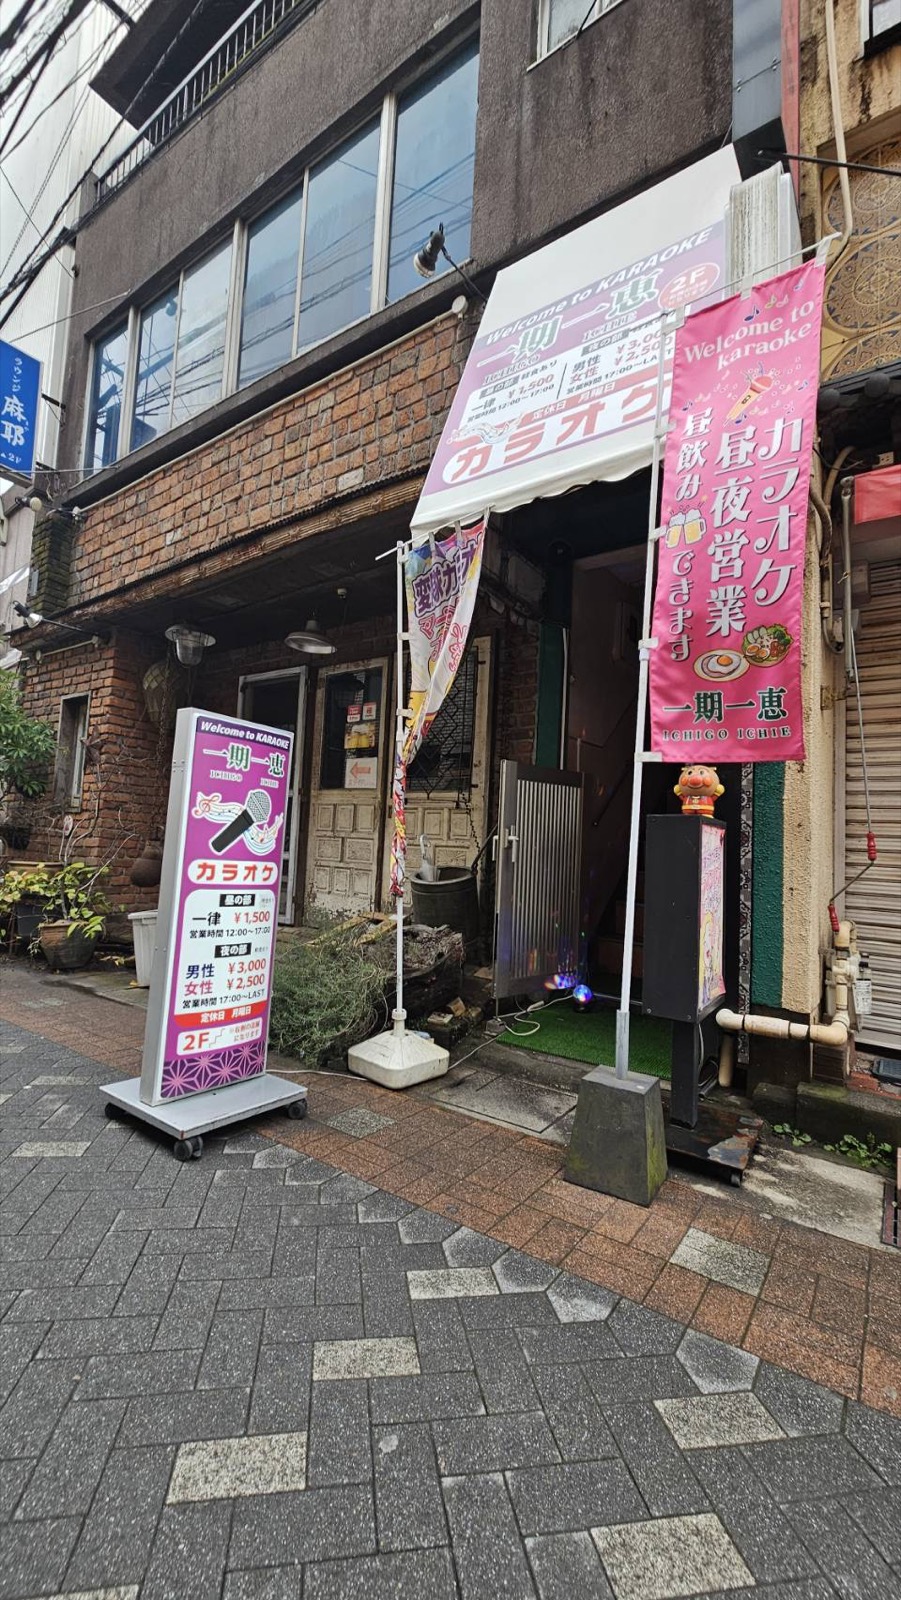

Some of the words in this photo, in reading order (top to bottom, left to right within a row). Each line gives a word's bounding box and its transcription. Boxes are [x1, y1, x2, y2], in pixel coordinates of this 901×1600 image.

[487, 298, 568, 345] Welcome
[571, 287, 592, 307] to
[598, 228, 712, 292] KARAOKE
[670, 266, 706, 293] 2F
[684, 316, 782, 363] Welcome
[791, 300, 815, 323] to
[717, 322, 812, 371] karaoke
[572, 355, 600, 373] 男性
[569, 366, 598, 385] 女性
[471, 398, 496, 411] 一律
[533, 400, 566, 419] 定休日
[578, 382, 615, 403] 月曜日
[675, 407, 713, 502] 昼飲み
[751, 417, 804, 607] カラオケ
[705, 425, 759, 638] 昼夜営業
[668, 550, 695, 662] できます
[663, 687, 787, 723] 一期一恵
[201, 721, 245, 739] Welcome
[245, 731, 255, 740] to
[256, 732, 289, 750] KARAOKE
[662, 728, 729, 742] ICHIGO
[737, 726, 792, 740] ICHIE
[202, 742, 285, 777] 一期一恵
[196, 862, 274, 882] カラオケ
[192, 912, 221, 926] 一律
[189, 929, 224, 939] 営業時間
[219, 944, 249, 957] 夜の部
[186, 964, 216, 979] 男性
[184, 981, 213, 996] 女性
[182, 997, 217, 1009] 営業時間
[200, 1011, 225, 1024] 定休日
[231, 1006, 252, 1019] 月曜日
[182, 1032, 210, 1051] 2F
